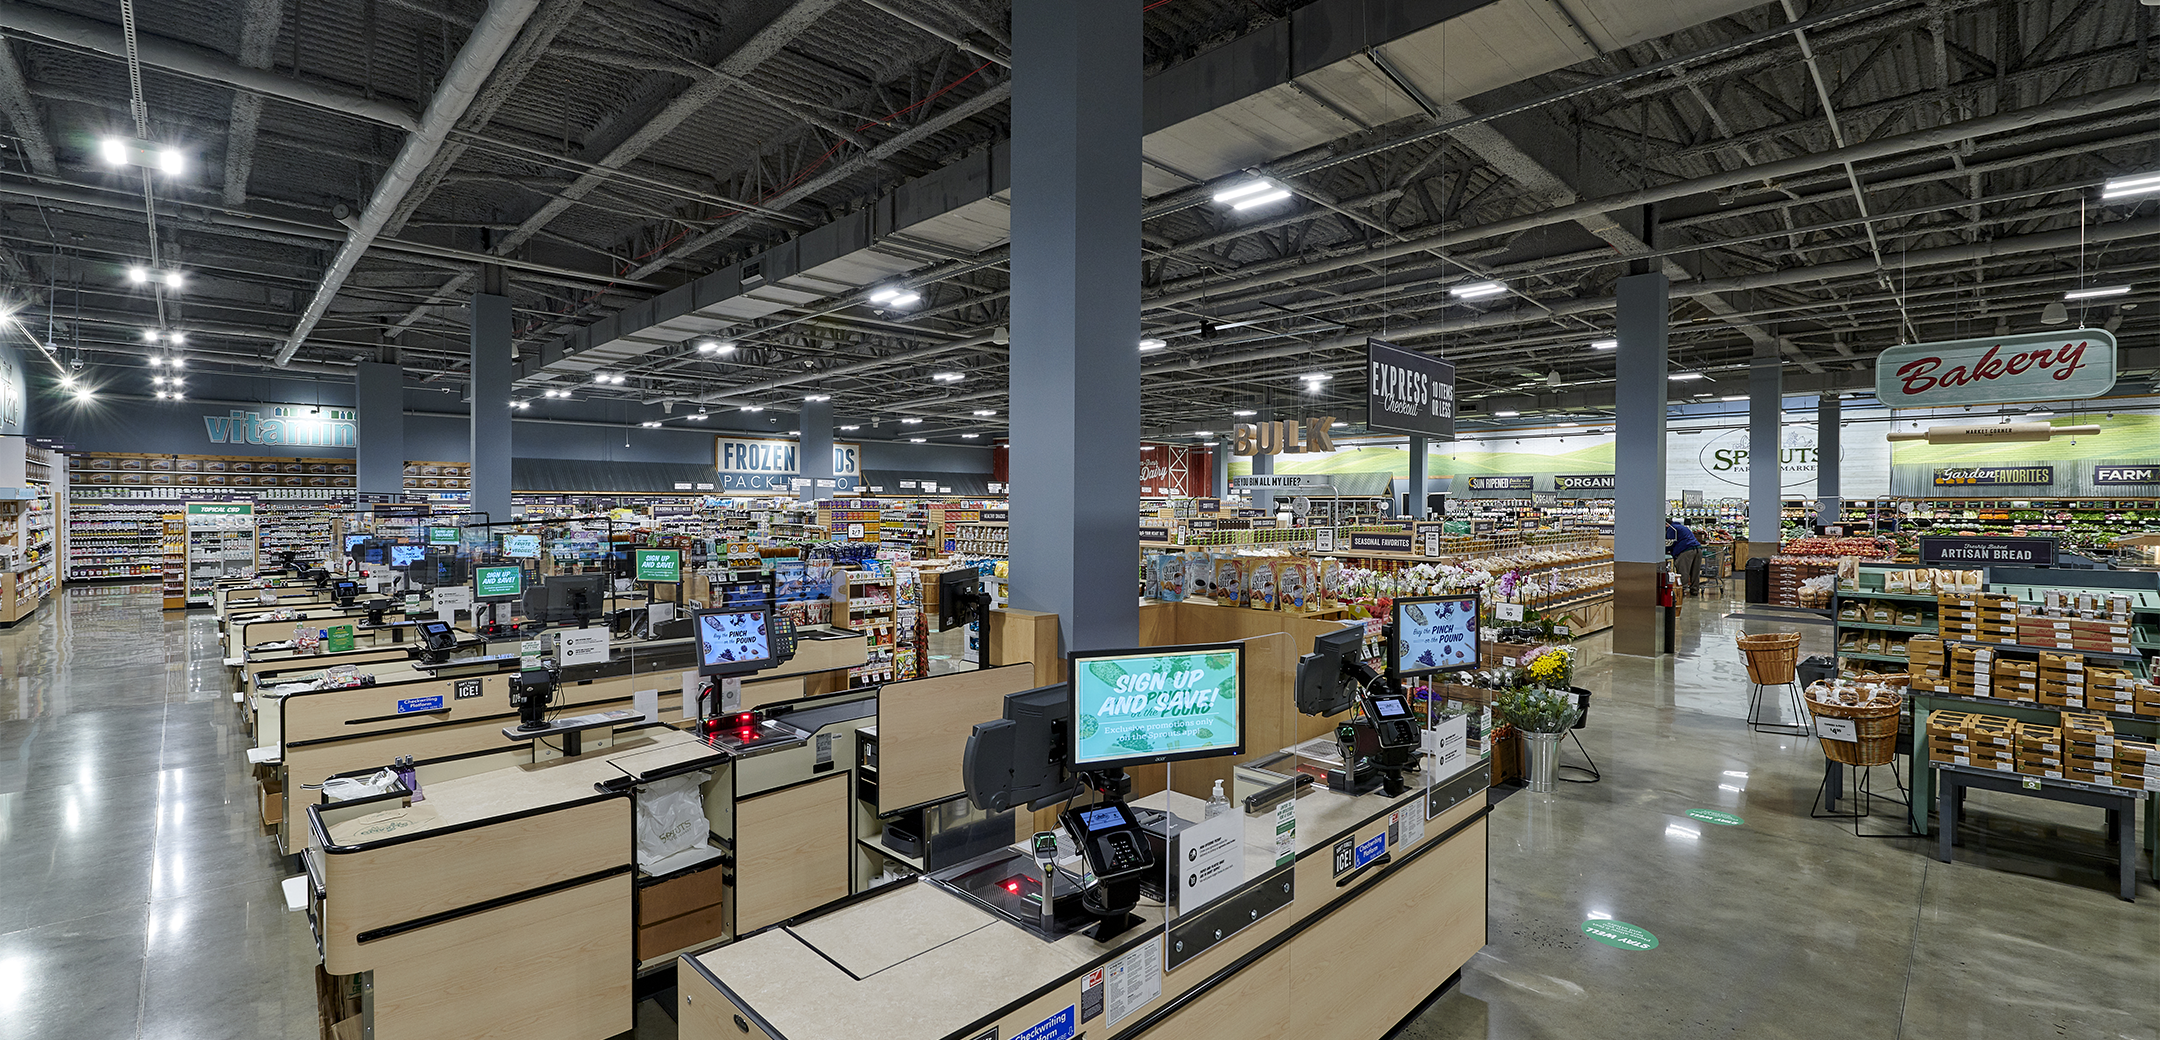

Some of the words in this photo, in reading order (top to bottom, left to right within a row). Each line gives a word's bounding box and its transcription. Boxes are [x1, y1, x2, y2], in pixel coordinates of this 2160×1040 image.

[1896, 341, 2088, 395] Bakery
[1373, 361, 1428, 405] EXPRESS
[1432, 381, 1438, 398] 10
[1439, 382, 1453, 401] ITEMS
[1384, 393, 1418, 416] Checkout
[1432, 399, 1439, 416] OR
[1440, 401, 1451, 418] LESS
[203, 409, 356, 448] vitamin
[1234, 416, 1336, 456] BULK
[724, 442, 795, 471] FROZEN
[1713, 448, 1818, 471] SPUTS
[1140, 466, 1168, 480] Dairy
[1942, 467, 1996, 481] Garden
[1994, 468, 2049, 483] FAVORITES
[2099, 470, 2151, 480] FARM
[724, 476, 793, 489] PACKI
[1260, 478, 1271, 486] ALL
[1272, 478, 1282, 486] MY
[1284, 478, 1301, 486] LIFE?
[1474, 478, 1485, 489] SUN
[1486, 478, 1509, 489] RIPENED
[1564, 478, 1615, 487] ORGANI
[1354, 538, 1380, 546] SEASONAL
[1382, 538, 1410, 547] FAVORITES
[1941, 549, 1989, 559] ARTISAN
[1994, 550, 2032, 560] BREAD
[486, 571, 501, 579] SIGN
[729, 630, 748, 638] PINCH
[1432, 624, 1454, 635] PINCH
[736, 636, 757, 644] POUND
[1438, 633, 1464, 644] POUND
[1114, 672, 1168, 694] SIGN
[1174, 669, 1205, 690] UP
[459, 686, 479, 698] ICE!
[404, 697, 438, 705] Checkwriting
[1097, 694, 1148, 717] AND
[1154, 687, 1220, 712] SAVE!
[1104, 724, 1145, 734] Exclusive
[1147, 720, 1194, 732] promotions
[1196, 718, 1214, 727] only
[1132, 732, 1148, 741] the
[1148, 730, 1181, 741] Sprouts
[1359, 836, 1382, 853] Checkwriting
[1336, 849, 1352, 872] ICE!
[1586, 927, 1617, 940] WELL
[1618, 938, 1651, 949] STAY
[1015, 1012, 1066, 1040] Checkwriting
[1039, 1028, 1058, 1040] tform
